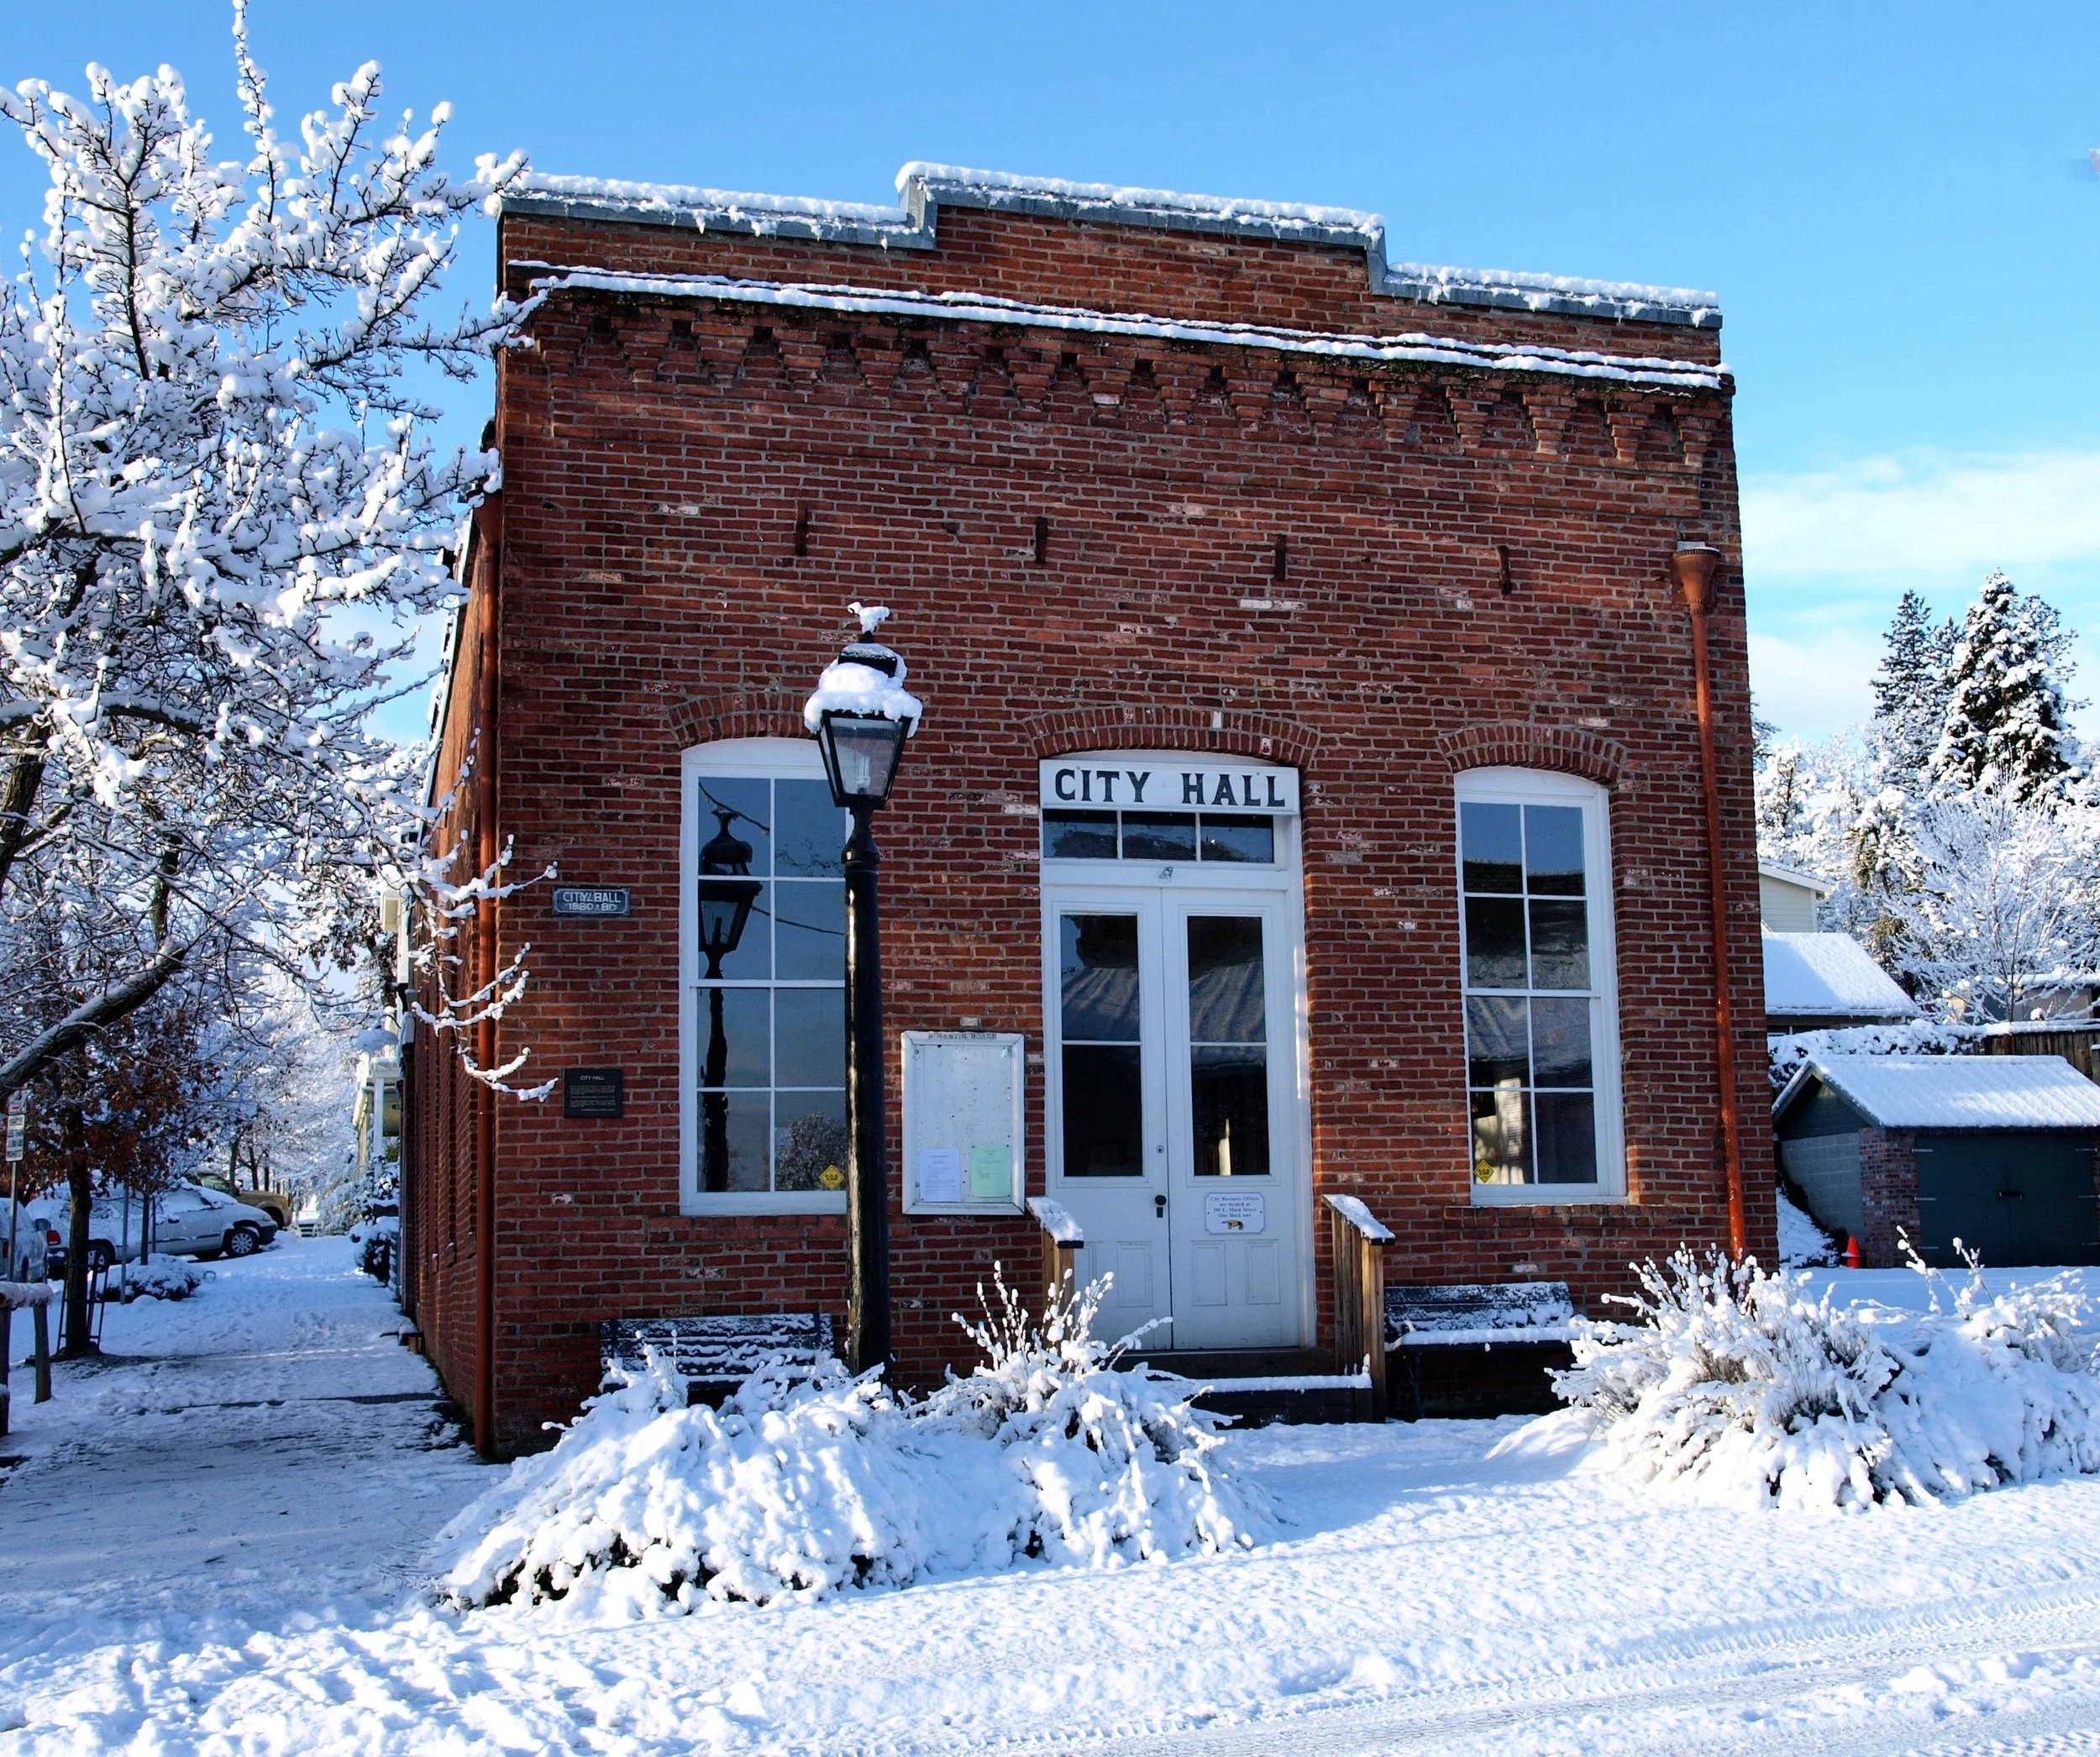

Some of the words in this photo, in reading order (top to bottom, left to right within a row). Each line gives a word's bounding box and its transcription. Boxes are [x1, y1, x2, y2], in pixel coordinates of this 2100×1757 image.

[1054, 768, 1151, 803] CITY
[1180, 773, 1285, 807] HALL
[563, 891, 588, 903] CITY
